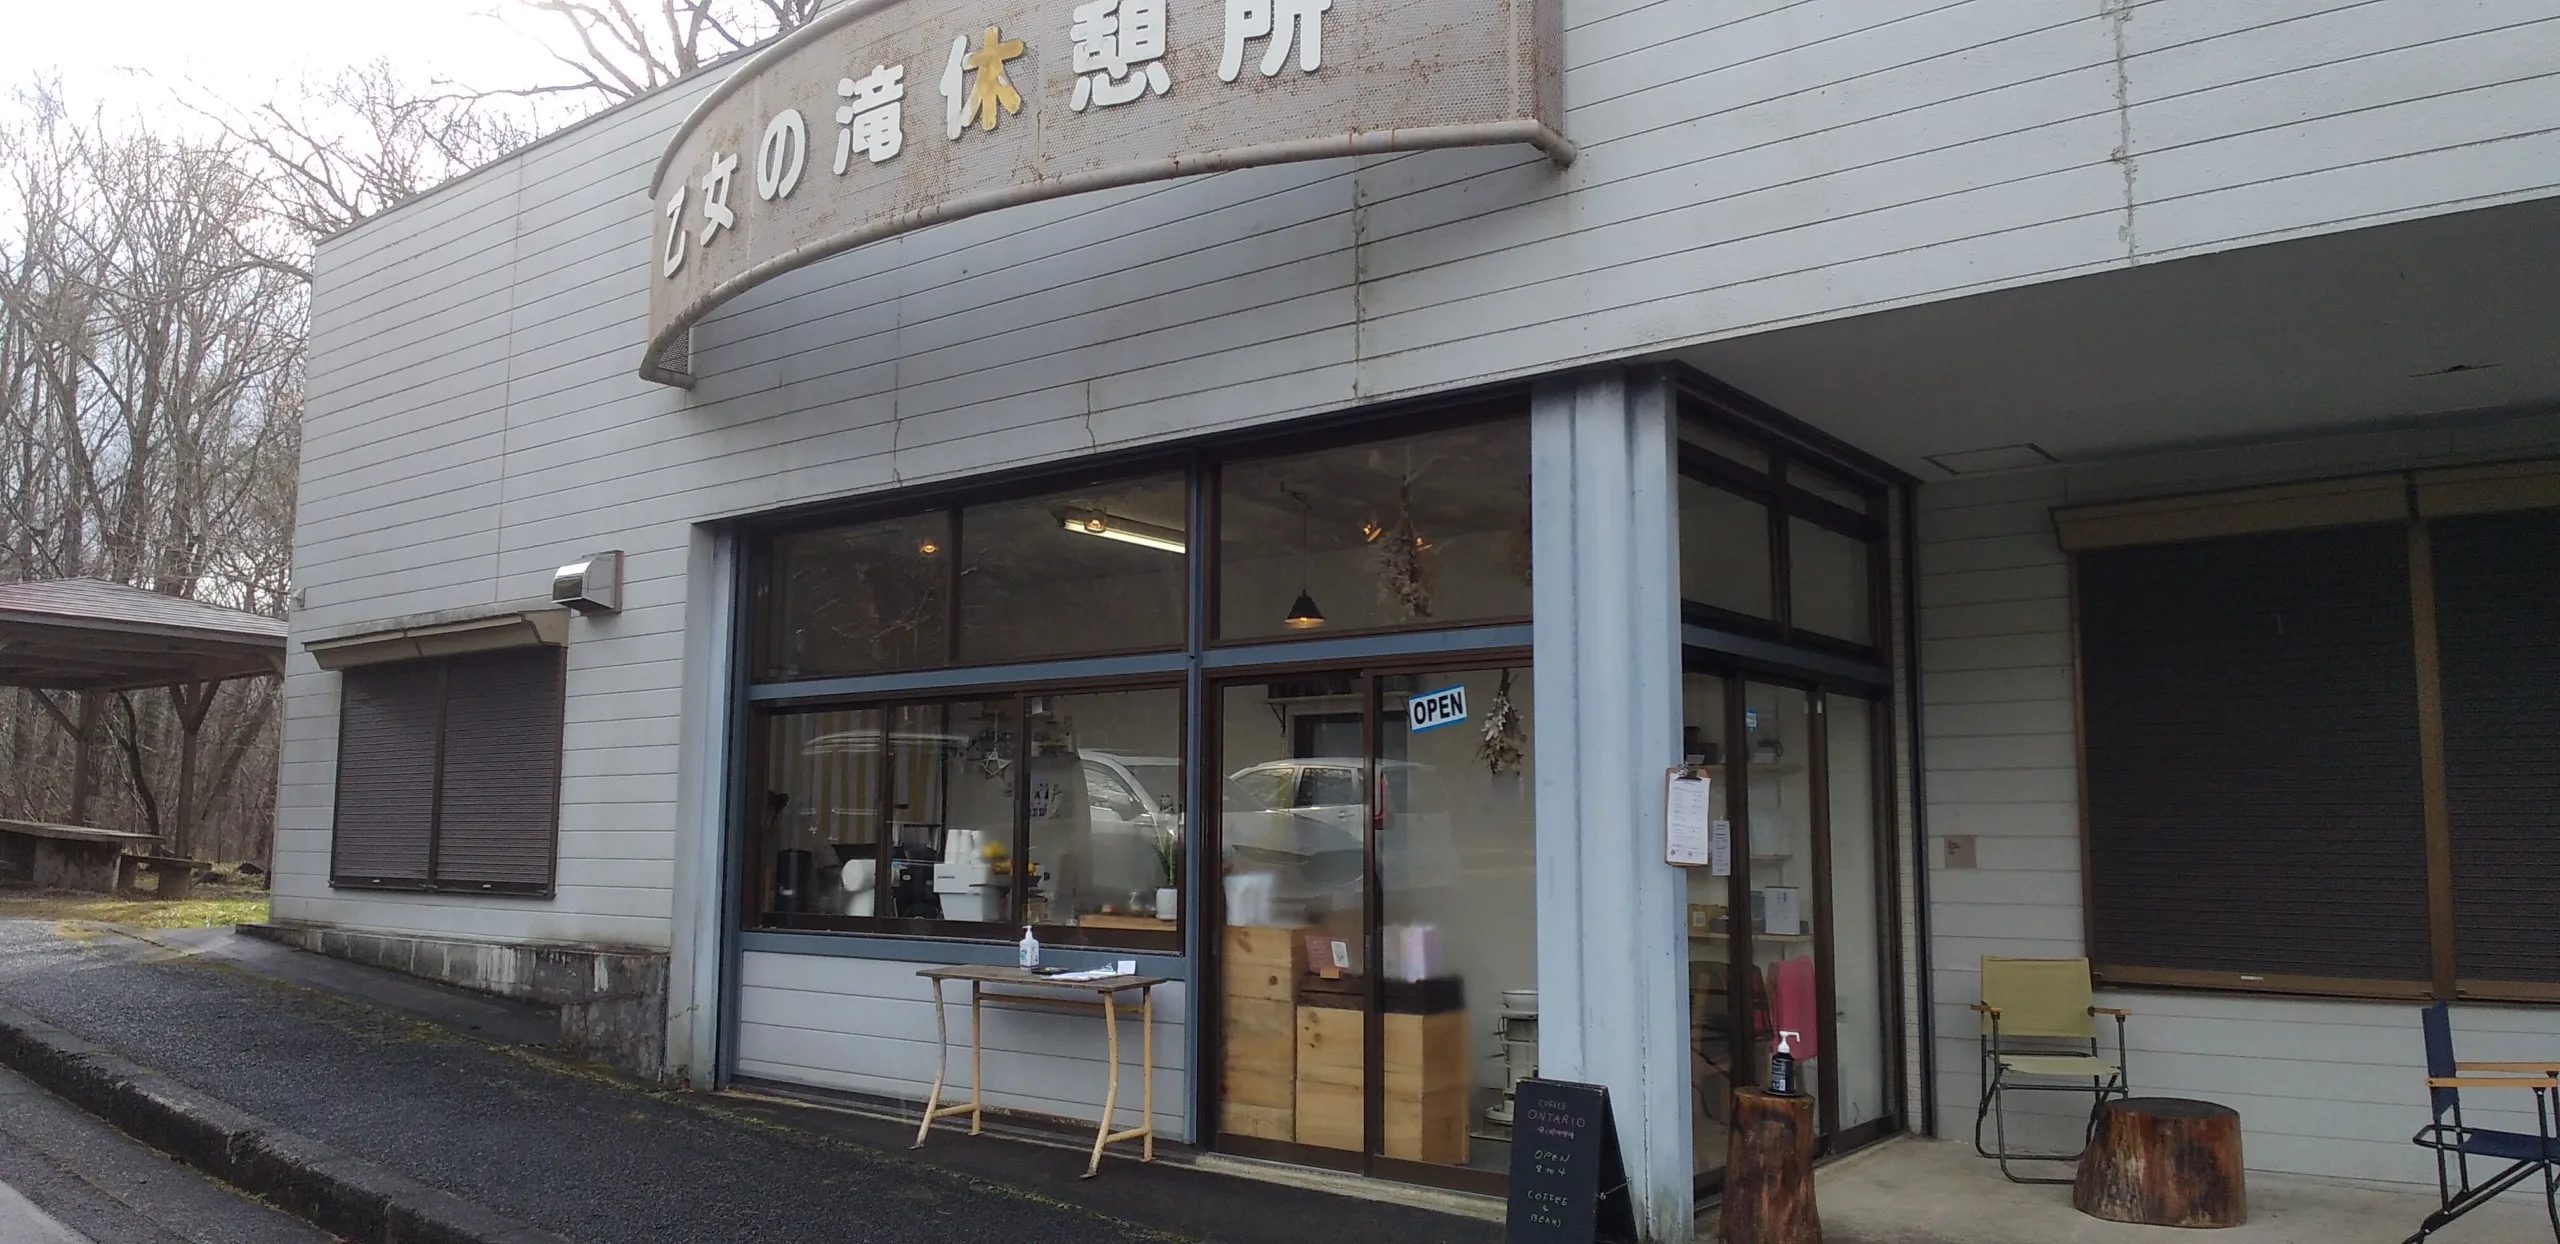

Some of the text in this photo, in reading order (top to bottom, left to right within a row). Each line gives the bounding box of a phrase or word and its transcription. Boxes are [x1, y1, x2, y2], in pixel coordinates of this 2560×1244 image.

[1414, 691, 1463, 724] OPEN
[1538, 1099, 1567, 1111] COFFEE
[1528, 1109, 1586, 1128] ONTARIO
[1534, 1150, 1570, 1162] OPEN
[1558, 1167, 1567, 1176] 4
[1527, 1190, 1568, 1206] COFFEE
[1530, 1213, 1562, 1227] BEANS
